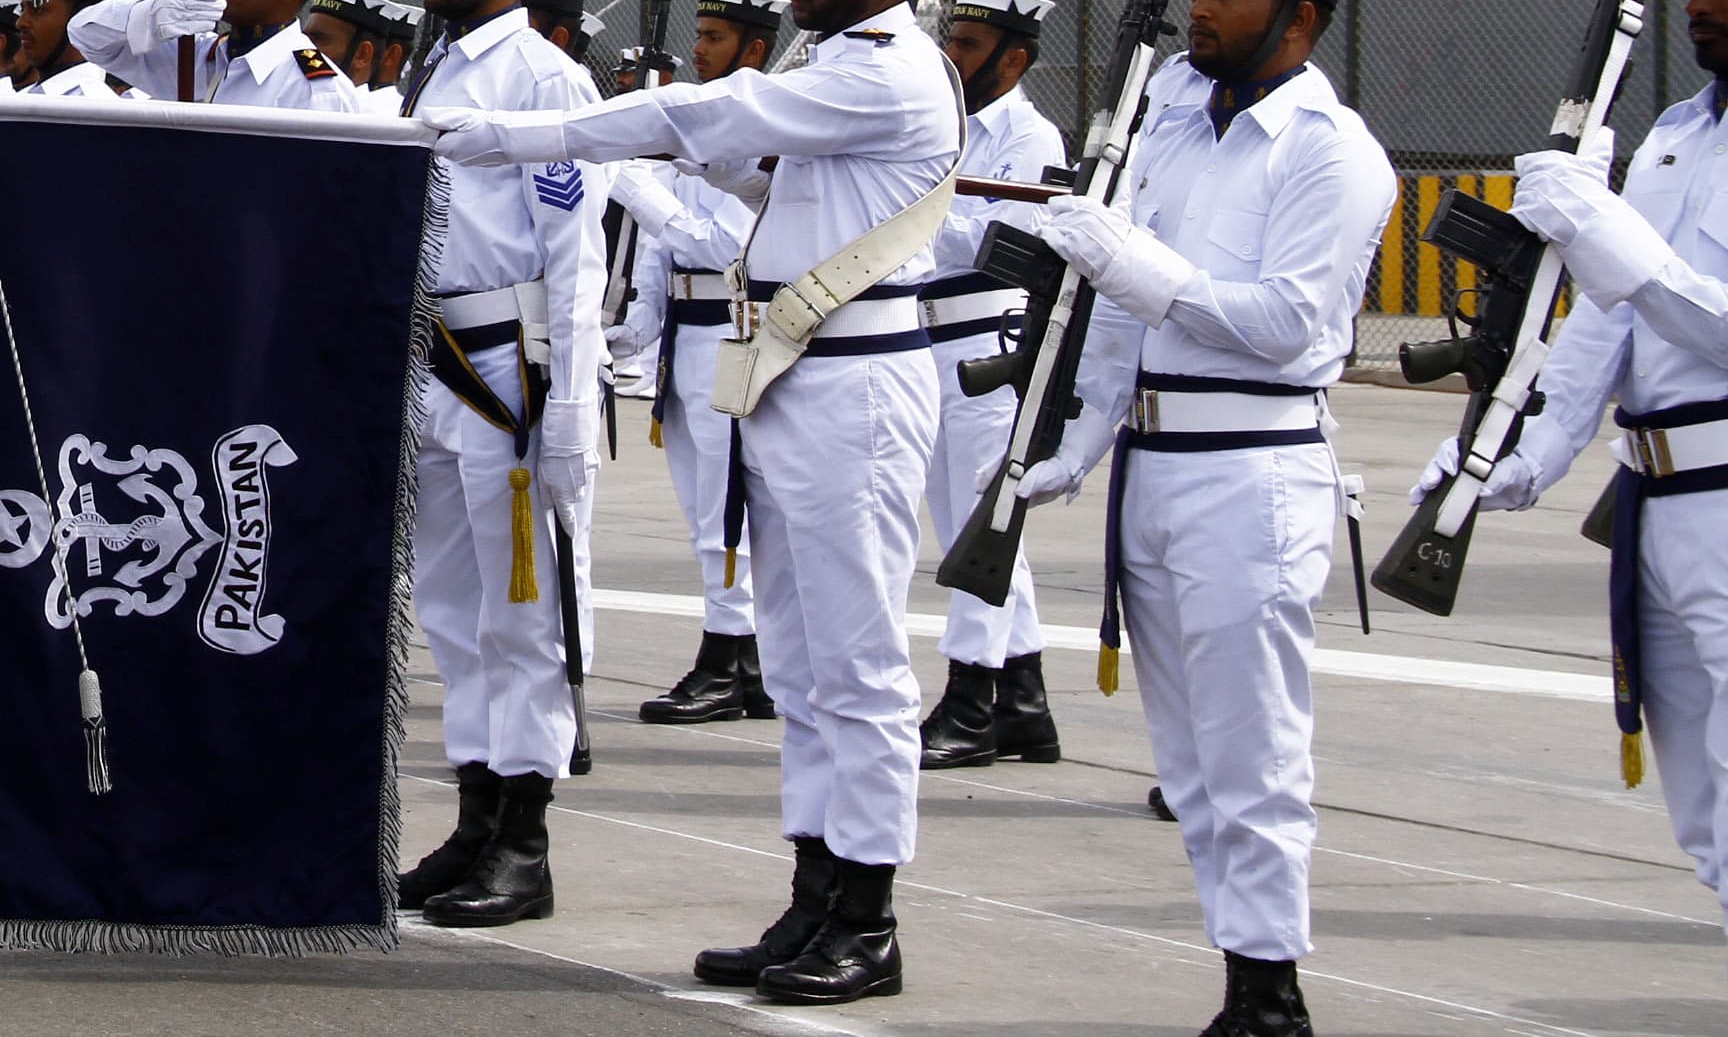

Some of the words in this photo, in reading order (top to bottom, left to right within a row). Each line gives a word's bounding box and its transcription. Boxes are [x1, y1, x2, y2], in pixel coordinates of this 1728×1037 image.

[705, 2, 726, 12] NAVY
[966, 6, 990, 18] NAVY
[215, 441, 265, 631] PAKISTAN
[1418, 542, 1452, 568] C-10
